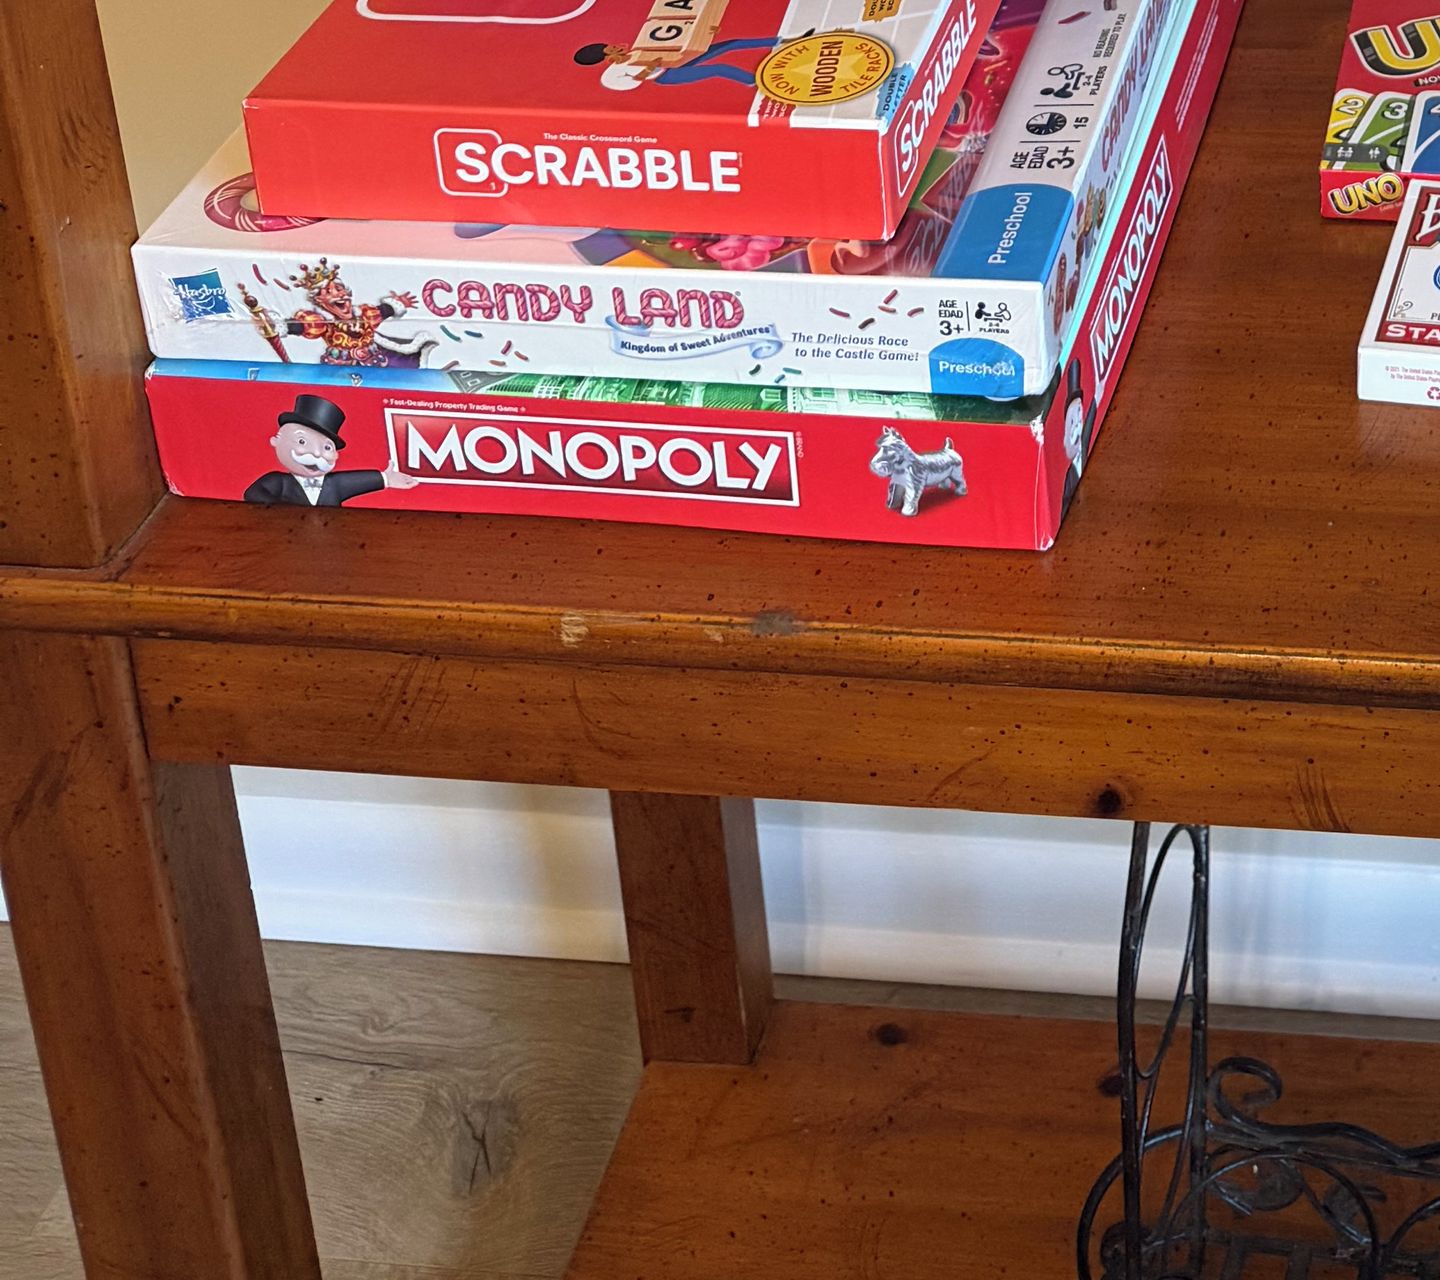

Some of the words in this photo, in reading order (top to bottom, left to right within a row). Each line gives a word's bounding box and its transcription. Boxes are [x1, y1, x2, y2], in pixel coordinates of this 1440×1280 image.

[773, 44, 810, 71] WITH
[855, 42, 881, 72] RACKS
[808, 40, 844, 97] WOODEN
[770, 72, 800, 96] NOW
[839, 72, 873, 94] TILE
[1089, 65, 1108, 96] PLAYERS
[1337, 98, 1365, 115] 2
[1384, 101, 1407, 119] 3
[1073, 116, 1089, 129] 15
[543, 132, 558, 140] The
[559, 133, 588, 141] Classic
[589, 134, 633, 143] Crossword
[634, 135, 658, 143] Game
[455, 141, 741, 193] SCRABBLE
[1010, 151, 1030, 169] AGE
[1046, 146, 1075, 169] 3+
[1331, 174, 1403, 215] UNO
[986, 191, 1033, 266] Preschool
[1095, 151, 1167, 375] MONOPOLY
[421, 278, 594, 325] CANDY
[611, 286, 745, 329] LAND
[938, 299, 958, 308] AGE
[938, 309, 964, 318] EDAD
[791, 332, 814, 344] The
[816, 333, 875, 346] Delicious
[878, 335, 909, 346] Race
[939, 320, 965, 336] 3+
[621, 340, 667, 354] Kingdom
[668, 342, 679, 353] of
[680, 338, 711, 350] Sweet
[794, 348, 808, 357] to
[811, 347, 832, 358] the
[835, 348, 875, 360] Castle
[878, 351, 920, 362] Game!
[434, 400, 468, 411] Property
[469, 402, 496, 412] Trading
[497, 404, 519, 413] Game
[408, 421, 782, 493] MONOPOLY
